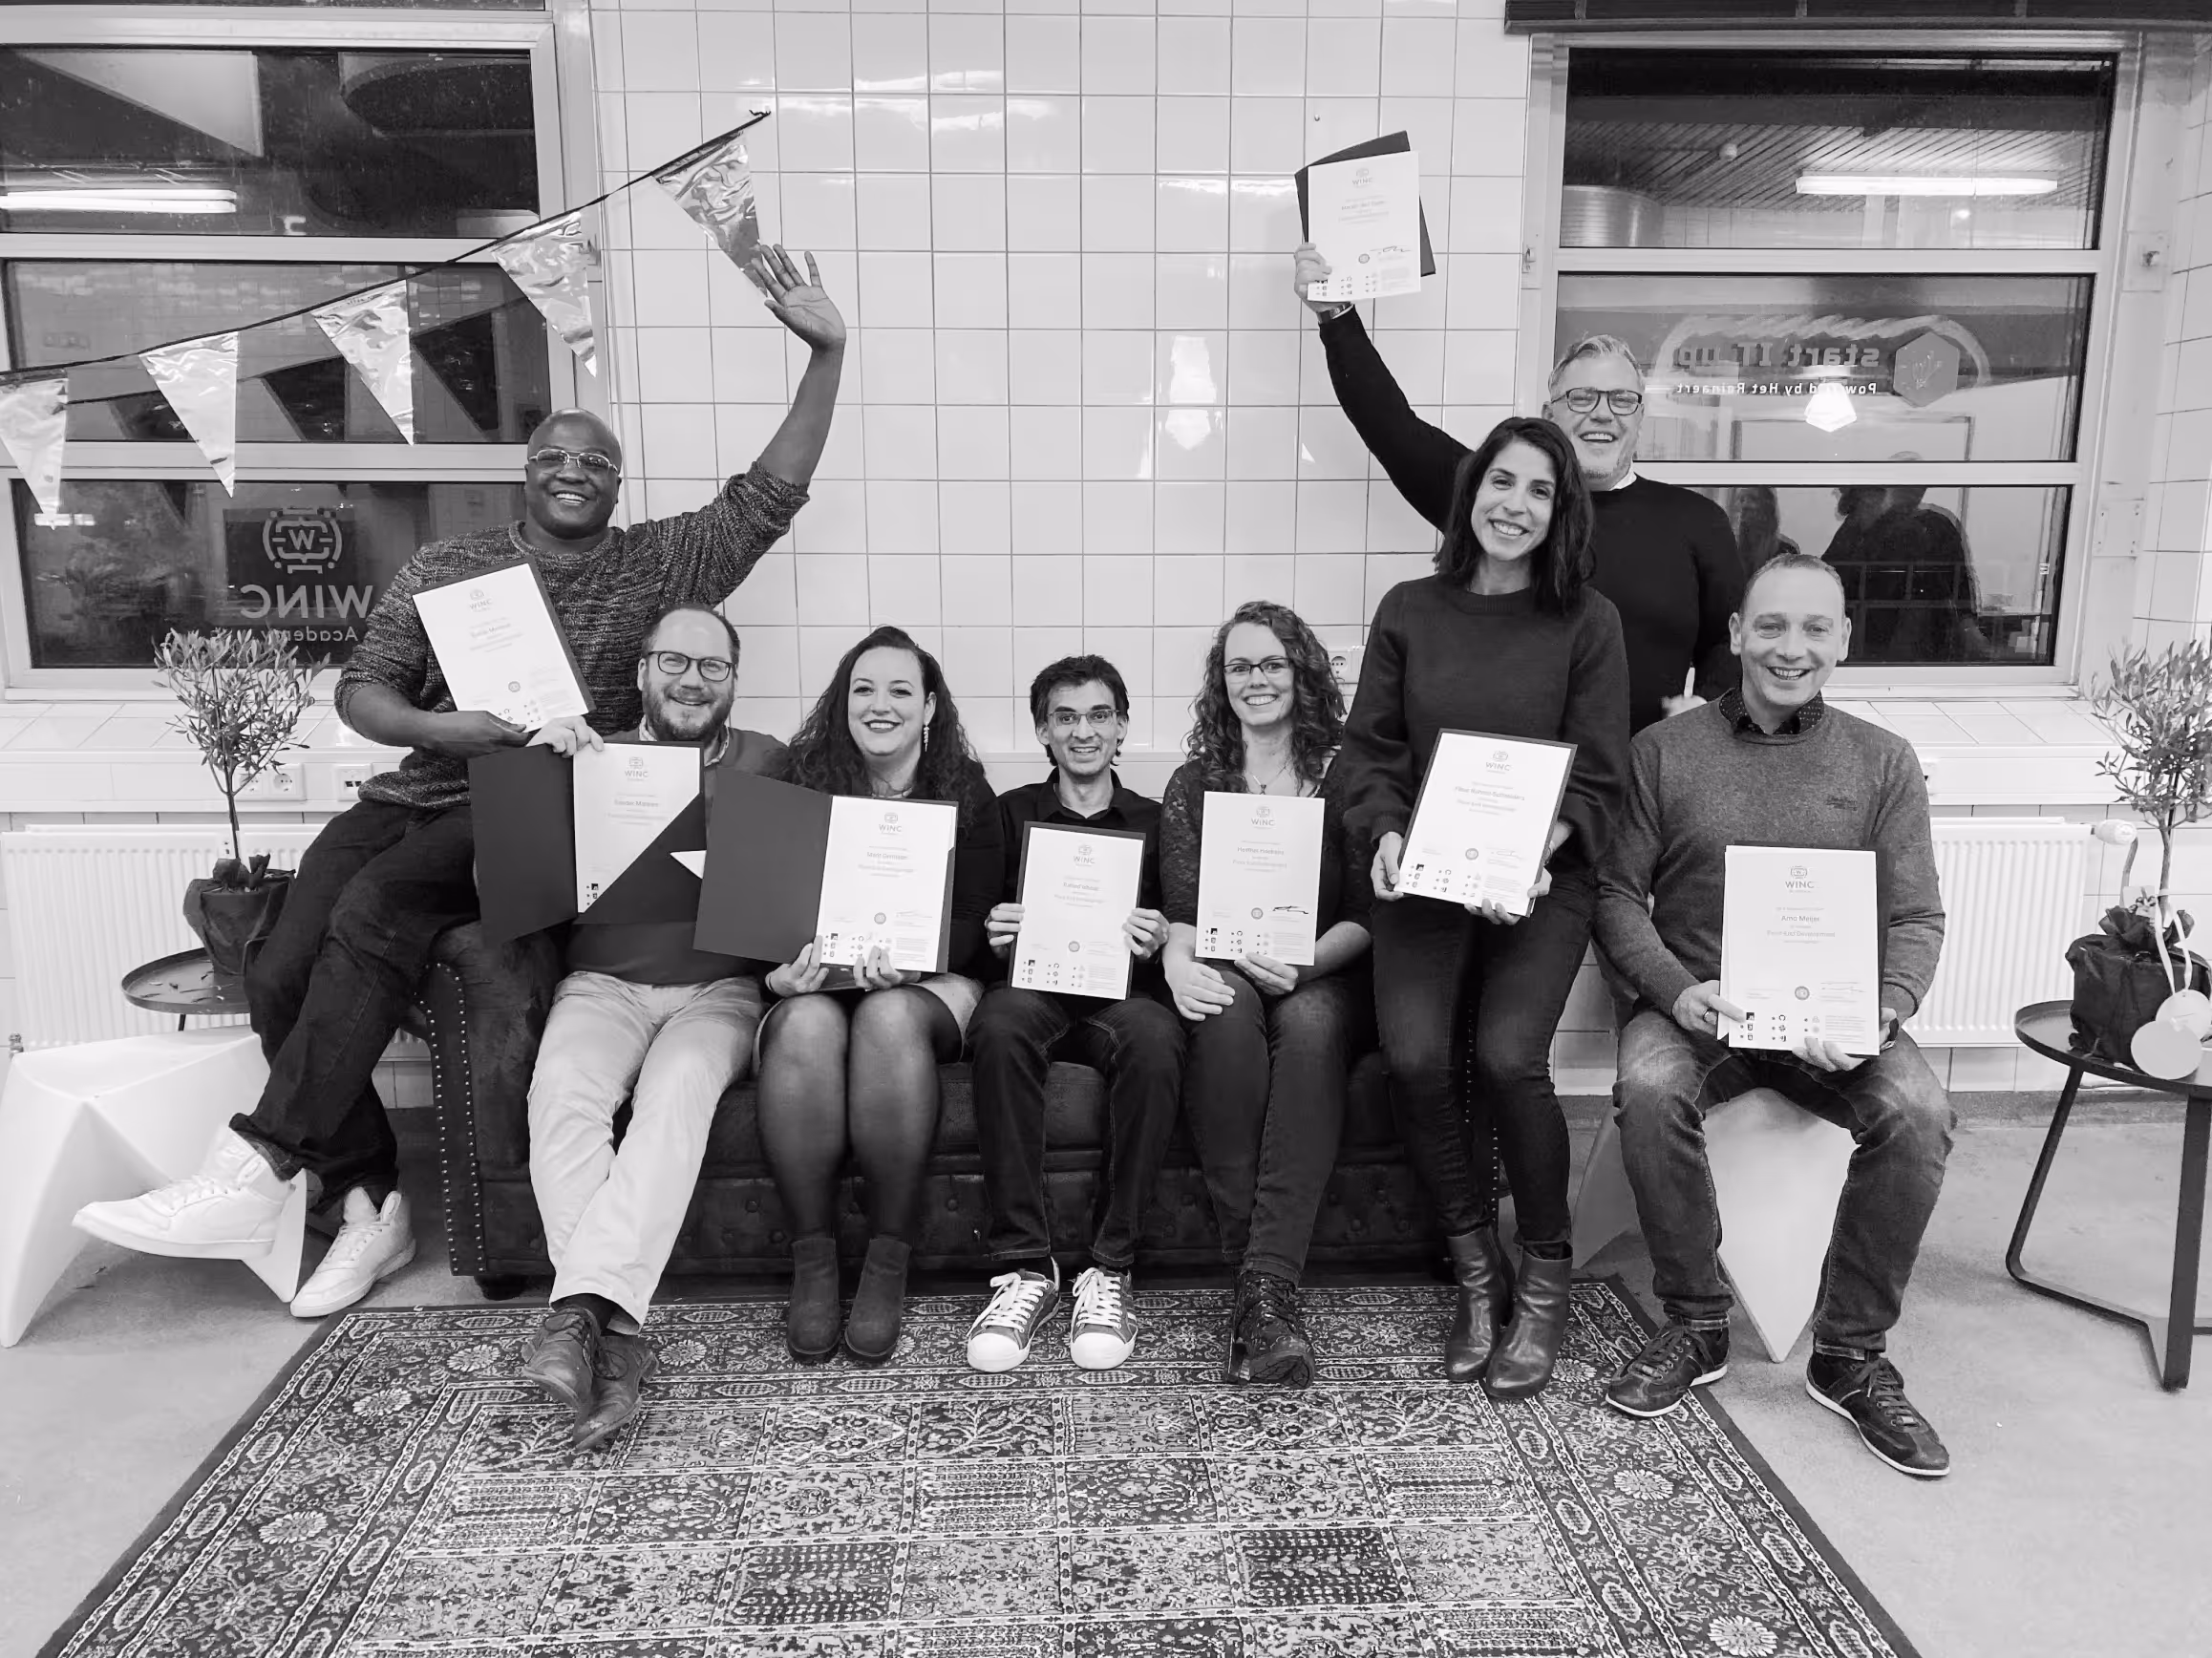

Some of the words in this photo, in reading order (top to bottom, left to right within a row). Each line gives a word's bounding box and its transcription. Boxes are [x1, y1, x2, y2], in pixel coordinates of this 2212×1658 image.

[1485, 761, 1511, 772] WINC
[625, 770, 649, 778] WINC
[1251, 818, 1275, 826] WINC
[879, 823, 903, 833] WINC
[1074, 855, 1095, 864] WINC
[1785, 881, 1815, 889] WINC
